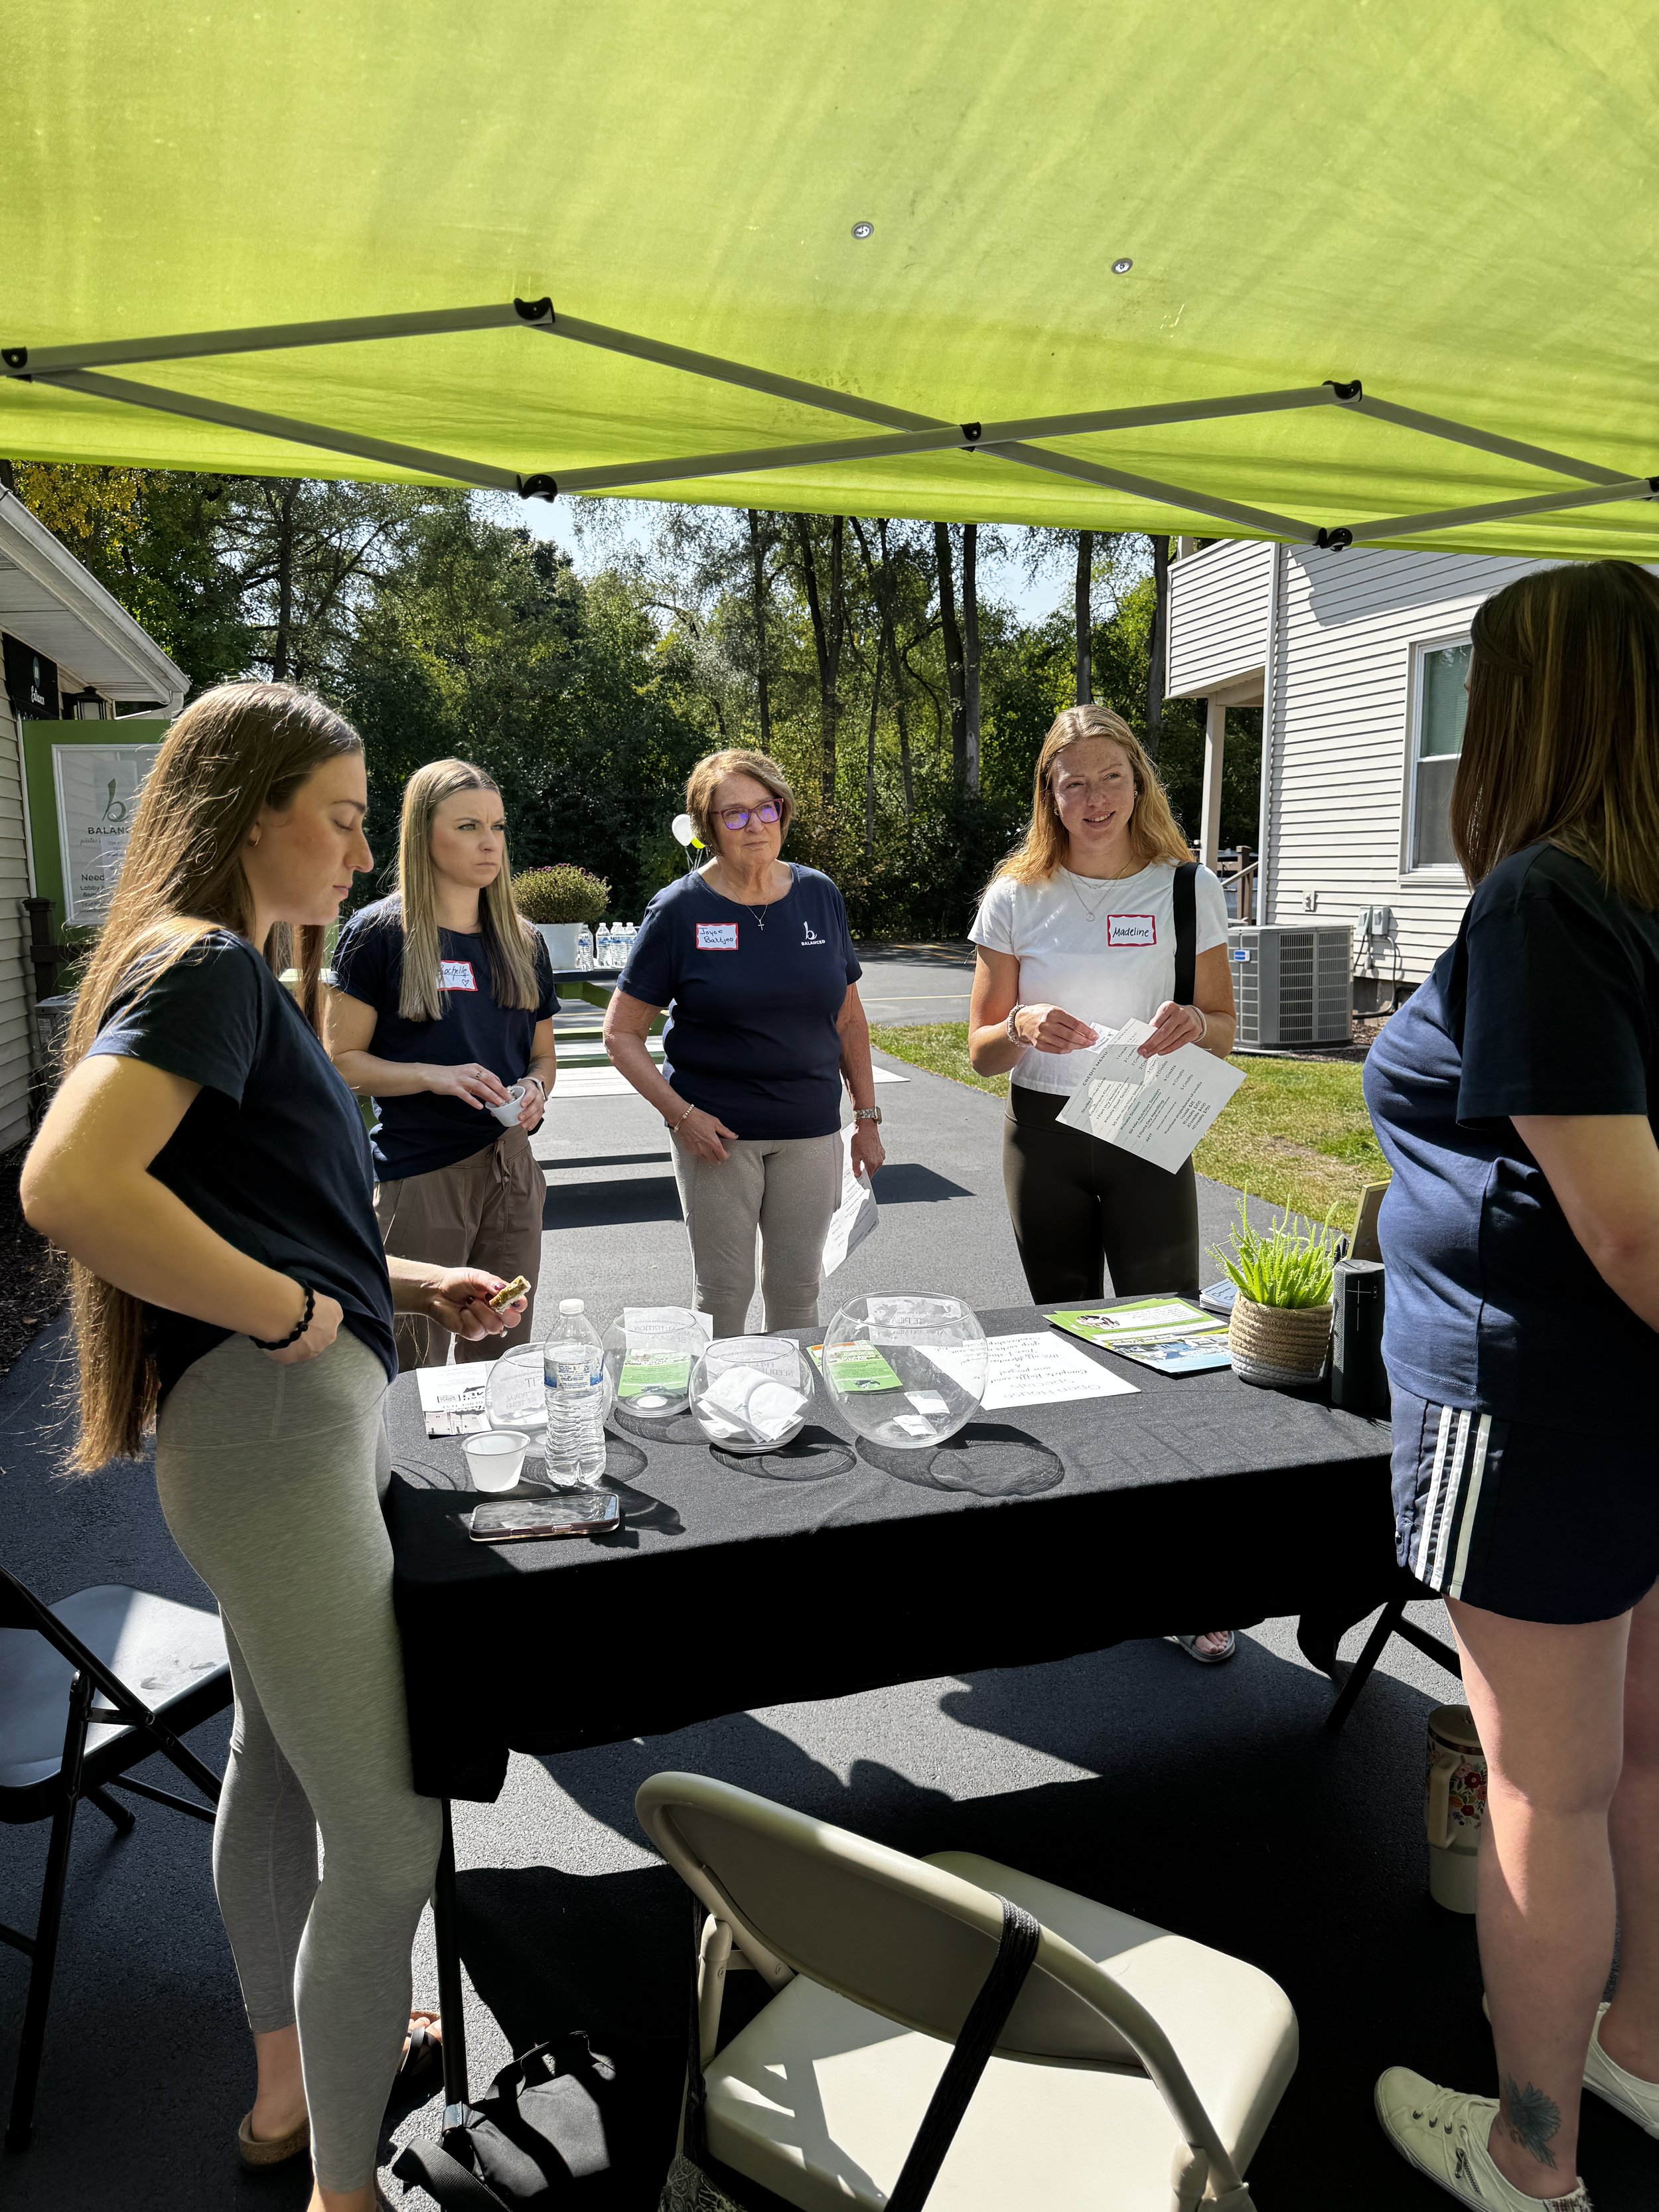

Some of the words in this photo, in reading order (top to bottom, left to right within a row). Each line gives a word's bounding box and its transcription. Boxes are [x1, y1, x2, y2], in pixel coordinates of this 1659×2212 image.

[31, 686, 45, 706] Entrance
[1113, 927, 1149, 938] Madeline
[1082, 1067, 1096, 1086] CREDIT
[1095, 1051, 1108, 1067] MENU
[1157, 1060, 1169, 1074] Credits
[1165, 1064, 1177, 1078] Credits
[1173, 1068, 1185, 1083] Credits
[1181, 1072, 1193, 1088] Credits
[1102, 1083, 1112, 1094] Class
[1108, 1082, 1122, 1101] Needling
[1104, 1108, 1114, 1122] Private
[1113, 1098, 1121, 1109] Duet
[1119, 1082, 1131, 1098] Session
[1120, 1095, 1134, 1113] Nutrition
[1131, 1080, 1144, 1096] Session
[1137, 1103, 1151, 1121] Nutrition
[1148, 1088, 1161, 1104] Session
[1163, 1117, 1177, 1134] Purchase
[1192, 1080, 1202, 1094] credits
[1119, 1115, 1131, 1130] Private
[1129, 1100, 1141, 1116] Session
[1138, 1124, 1147, 1135] Parts
[1150, 1099, 1165, 1118] Needling
[1181, 1107, 1190, 1118] credit
[1185, 1108, 1195, 1121] credits
[1189, 1110, 1199, 1123] credits
[1194, 1113, 1204, 1126] credits
[1015, 1372, 1043, 1380] Raffle
[1046, 1366, 1087, 1378] Complete
[1010, 1377, 1074, 1390] Specials
[1056, 1383, 1100, 1394] Open
[1003, 1388, 1054, 1399] House
